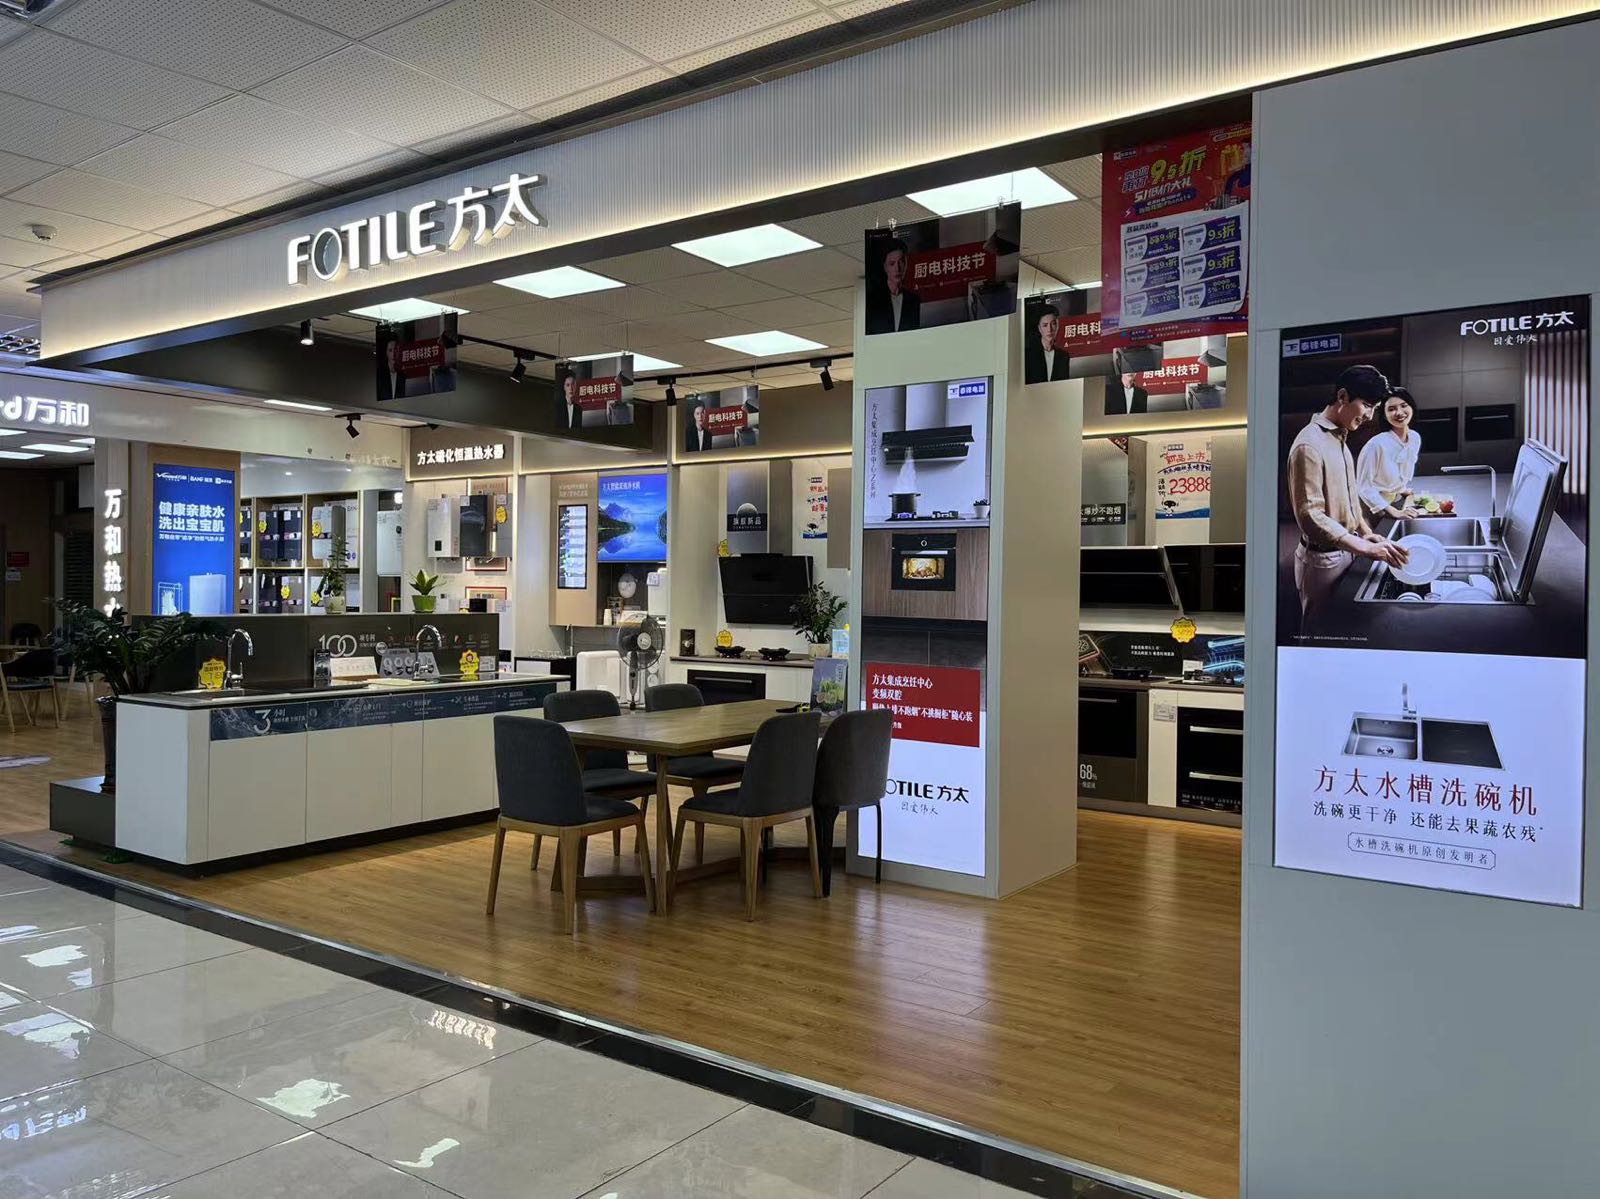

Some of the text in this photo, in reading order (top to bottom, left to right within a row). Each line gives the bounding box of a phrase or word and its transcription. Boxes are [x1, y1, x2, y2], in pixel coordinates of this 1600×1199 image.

[287, 174, 543, 285] FOTILE 方太
[914, 252, 986, 279] 厨电科技节
[1460, 310, 1575, 336] FOTILE 方太
[1494, 333, 1538, 346] 因爱伟大
[402, 346, 439, 362] 厨电科技节
[579, 383, 616, 397] 厨电科技节
[708, 411, 744, 424] 厨电科技节
[417, 444, 505, 466] 方太磁化恒温热水器
[159, 501, 226, 518] 健康亲肤水
[159, 516, 226, 533] 洗出宝宝肌
[872, 673, 934, 690] 方太集成烹饪中心
[884, 778, 969, 804] OTILE 方太
[1313, 765, 1538, 816] 方太水槽洗碗机
[901, 801, 939, 815] 因爱伟大
[1313, 800, 1398, 824] 洗碗更干净
[1355, 837, 1489, 866] 水槽洗碗机原创发明者
